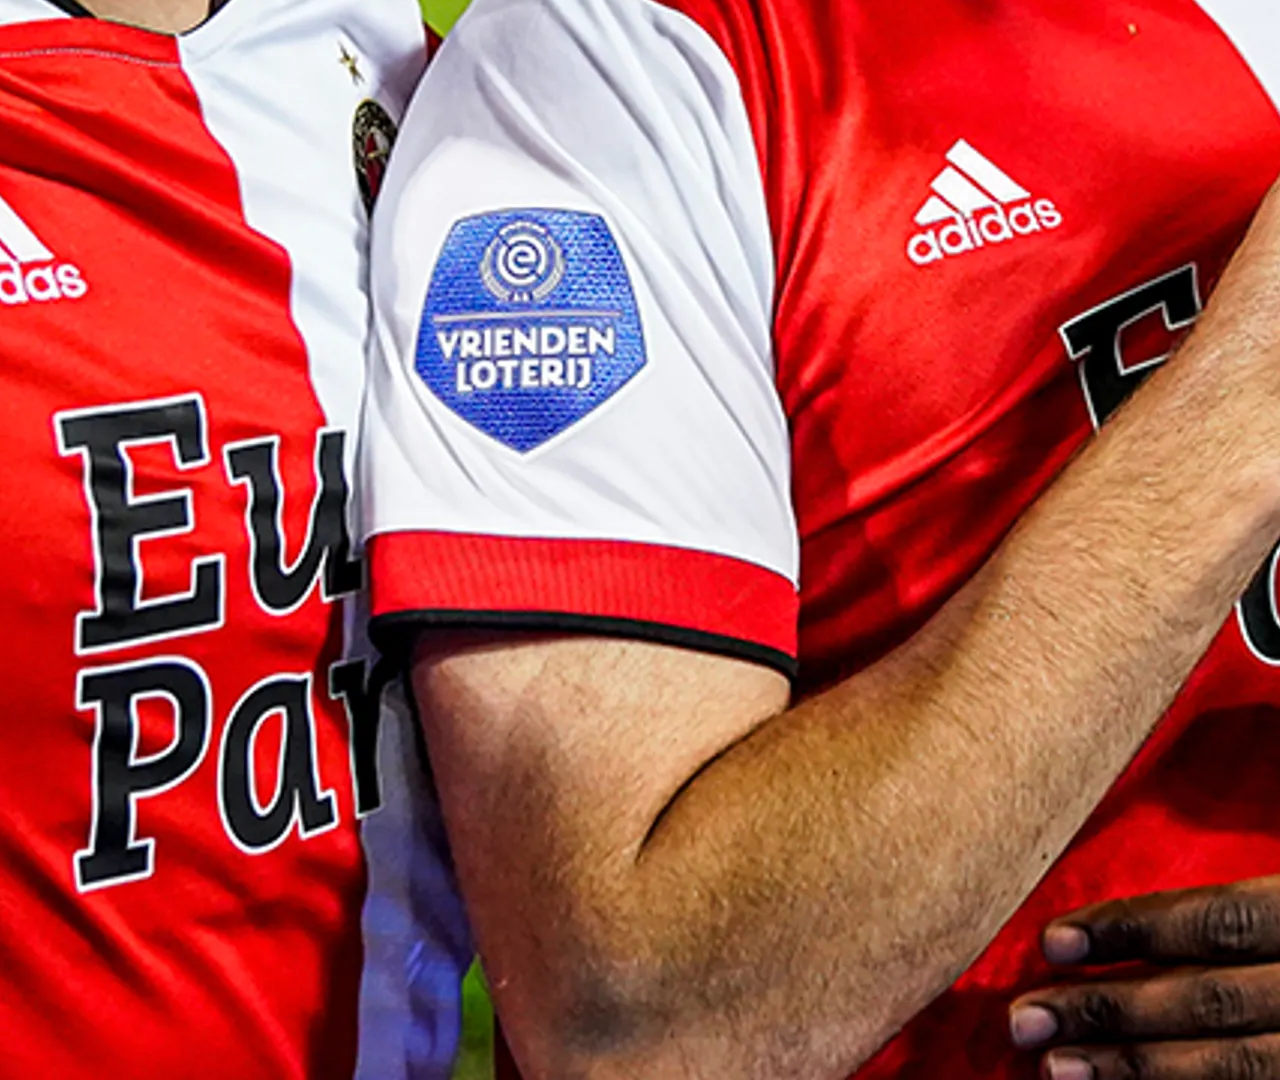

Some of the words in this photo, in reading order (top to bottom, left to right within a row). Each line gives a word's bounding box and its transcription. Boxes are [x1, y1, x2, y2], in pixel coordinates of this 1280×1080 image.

[906, 198, 1063, 266] adidas
[435, 325, 616, 360] VRIENDEN
[455, 357, 592, 392] LOTERIJ
